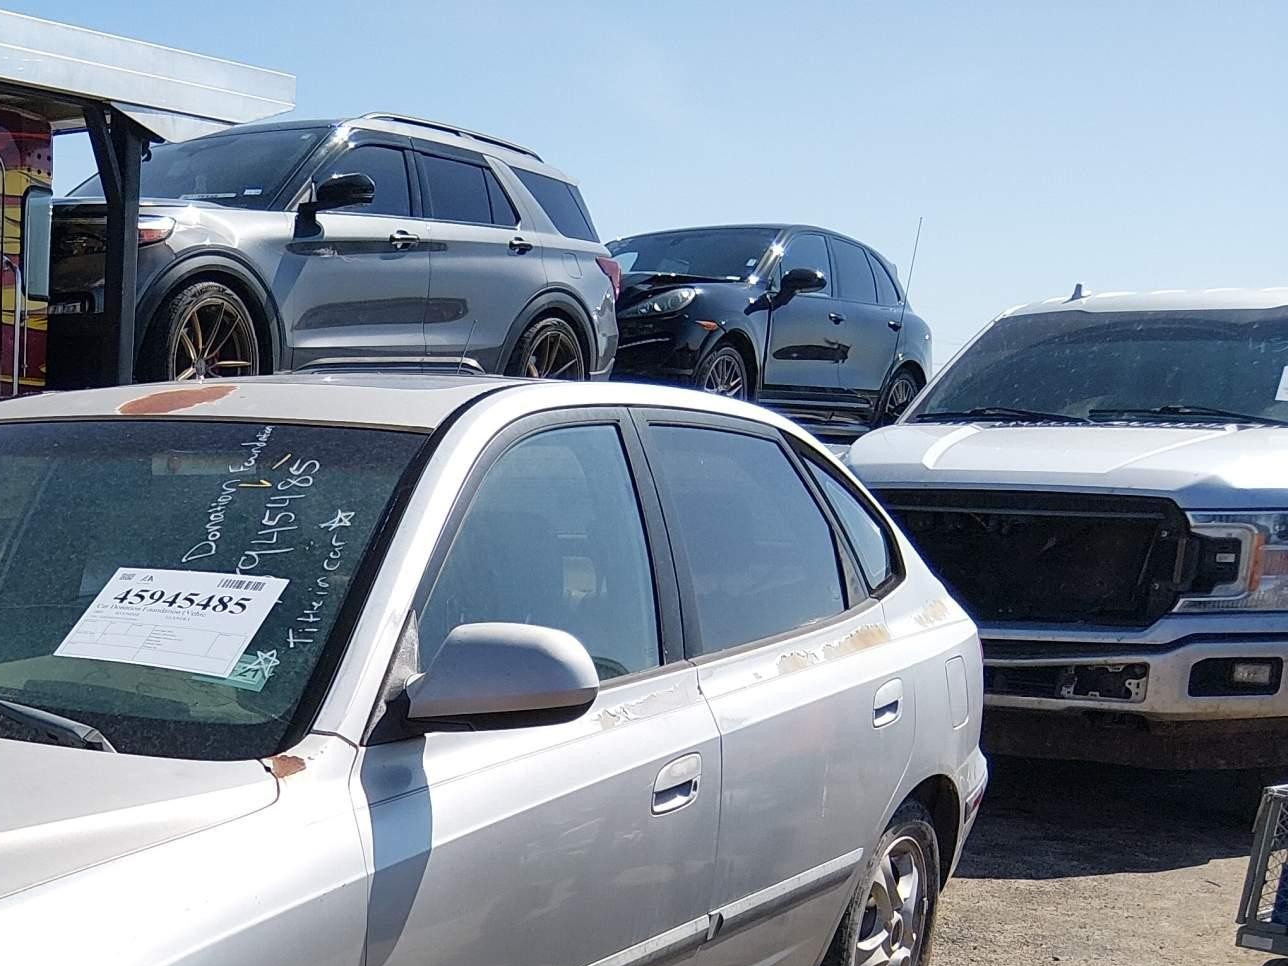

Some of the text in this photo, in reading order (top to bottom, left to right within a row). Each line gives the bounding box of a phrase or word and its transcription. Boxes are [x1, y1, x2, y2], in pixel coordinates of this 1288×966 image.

[182, 479, 241, 563] Donation
[236, 458, 320, 575] 945485
[323, 534, 348, 571] car
[113, 588, 253, 615] 45945485
